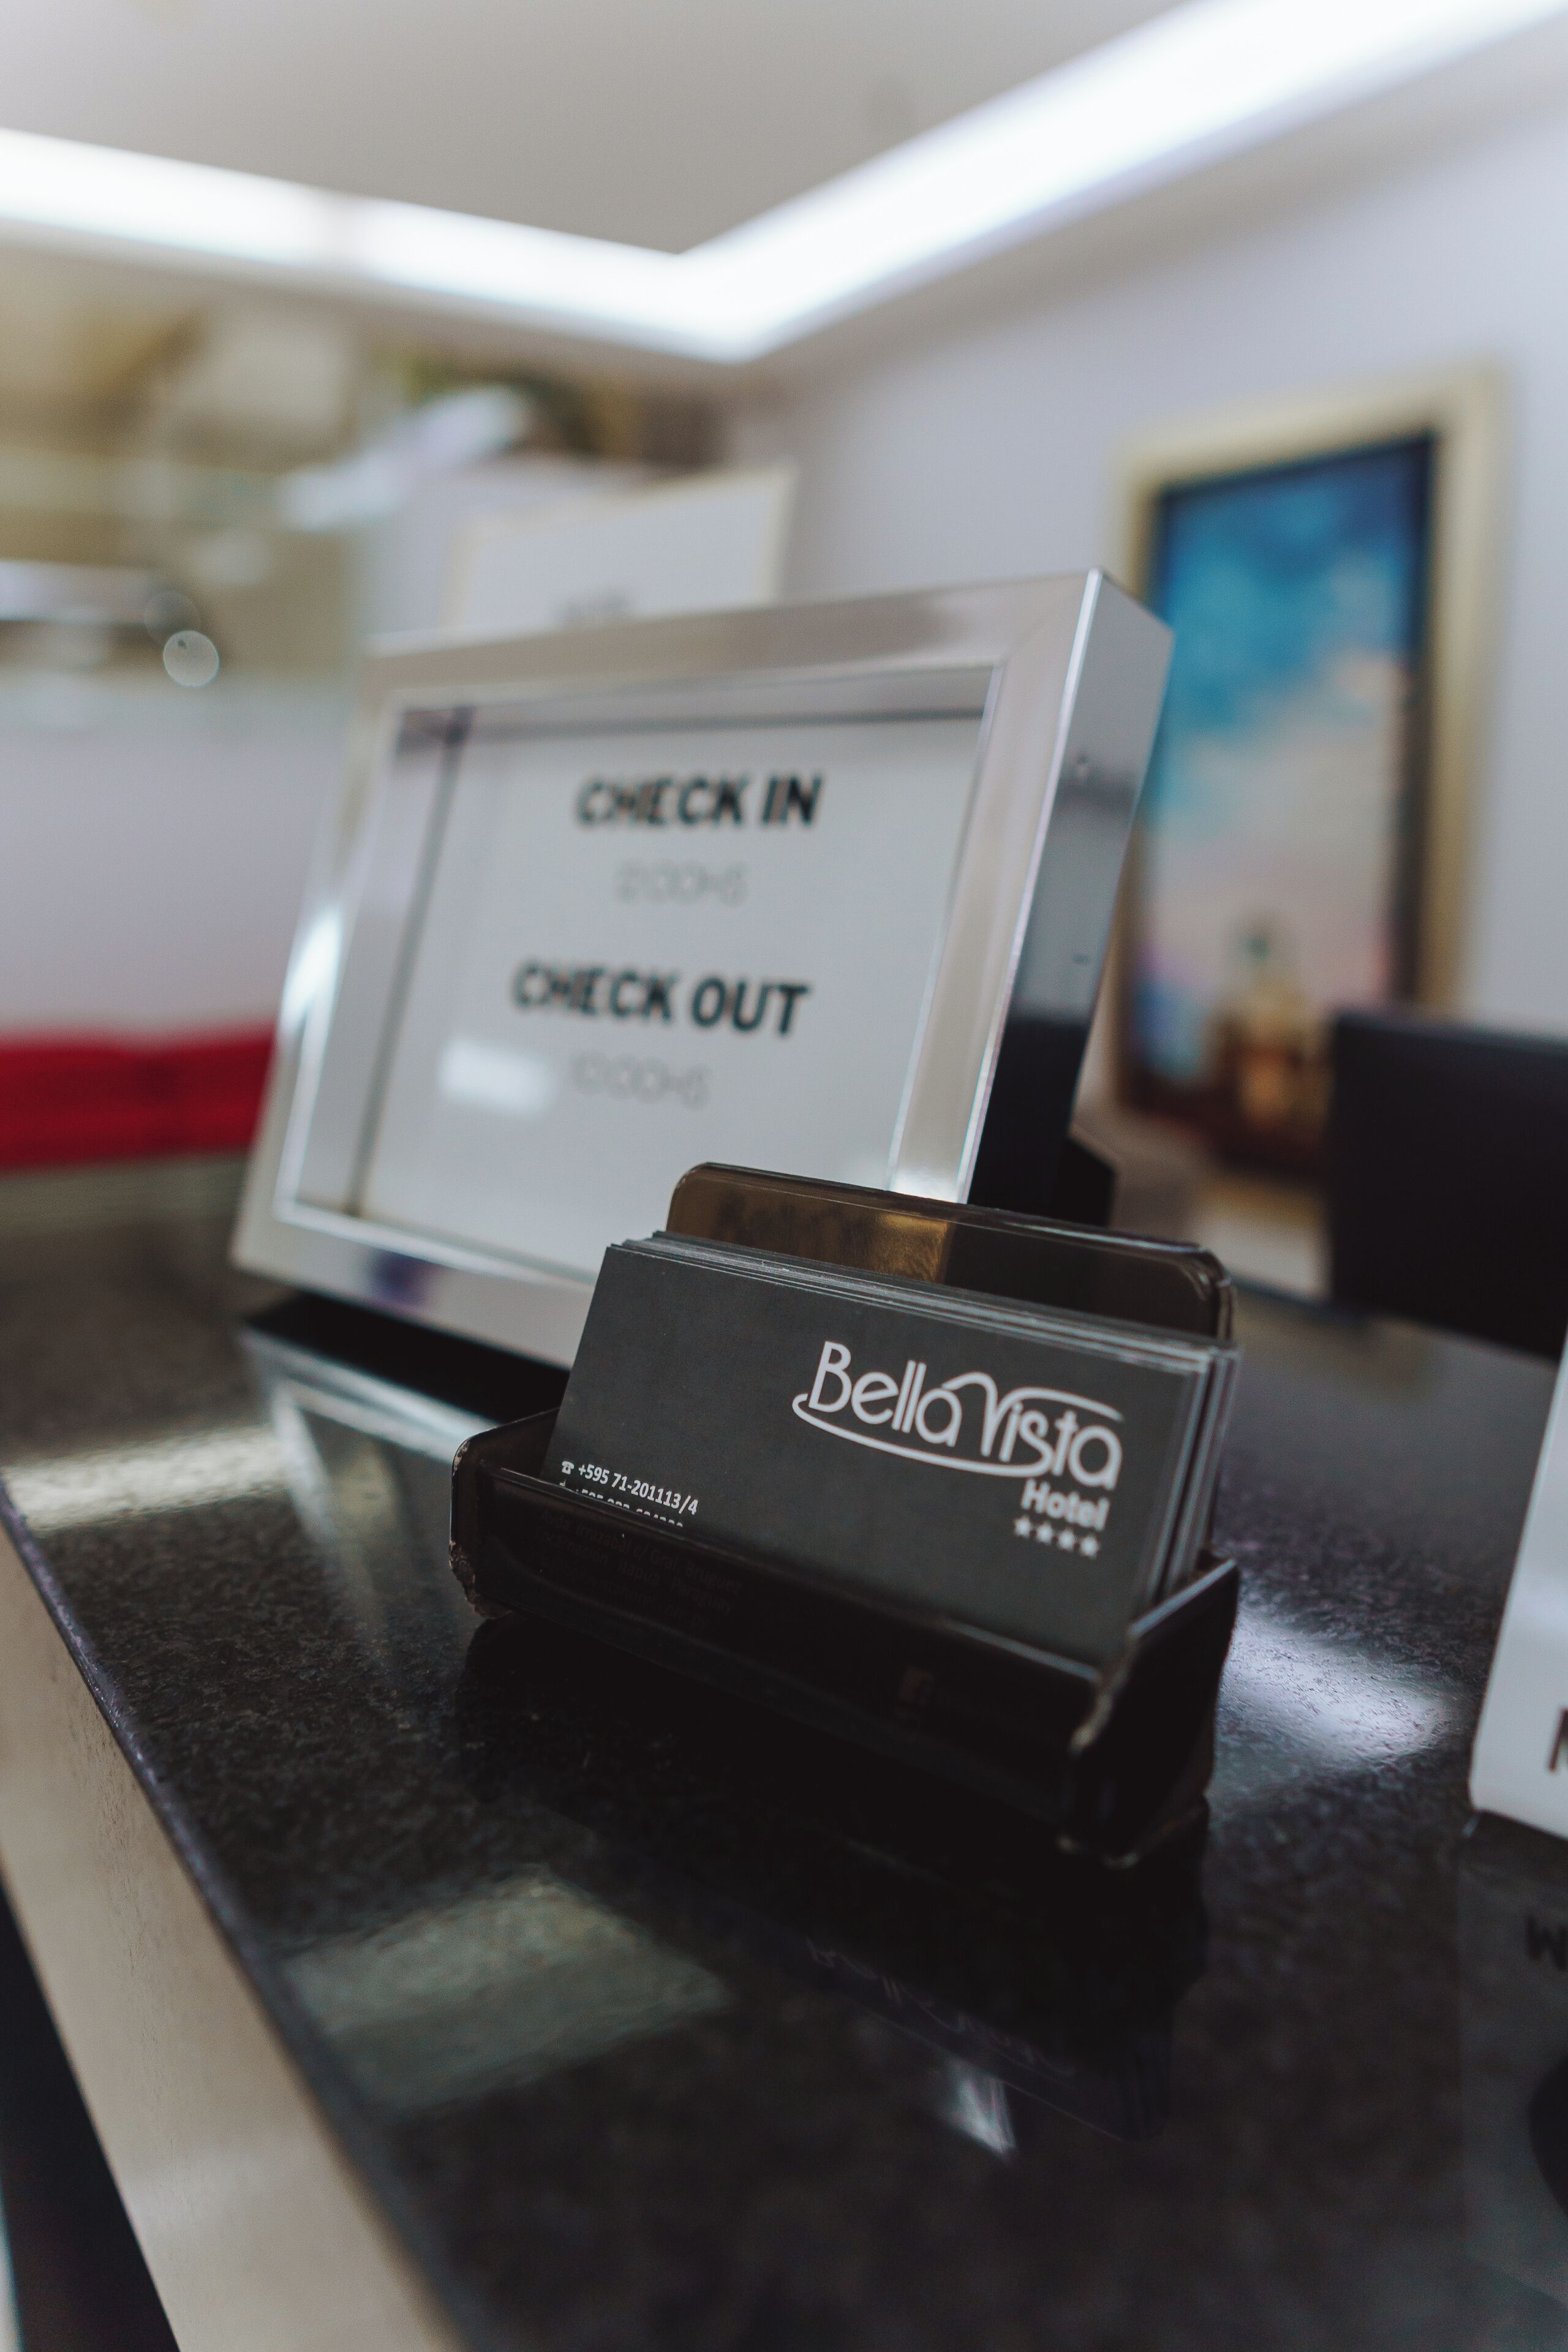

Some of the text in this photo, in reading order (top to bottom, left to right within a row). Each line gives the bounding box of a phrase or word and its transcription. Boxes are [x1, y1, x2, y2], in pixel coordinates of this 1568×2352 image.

[576, 773, 823, 828] CHECK IN
[513, 959, 810, 1035] CHECK OUT
[809, 1340, 1124, 1490] Bella Vista
[578, 1464, 610, 1485] +595
[611, 1472, 699, 1515] 71-201113/4
[1020, 1478, 1110, 1532] Hotel
